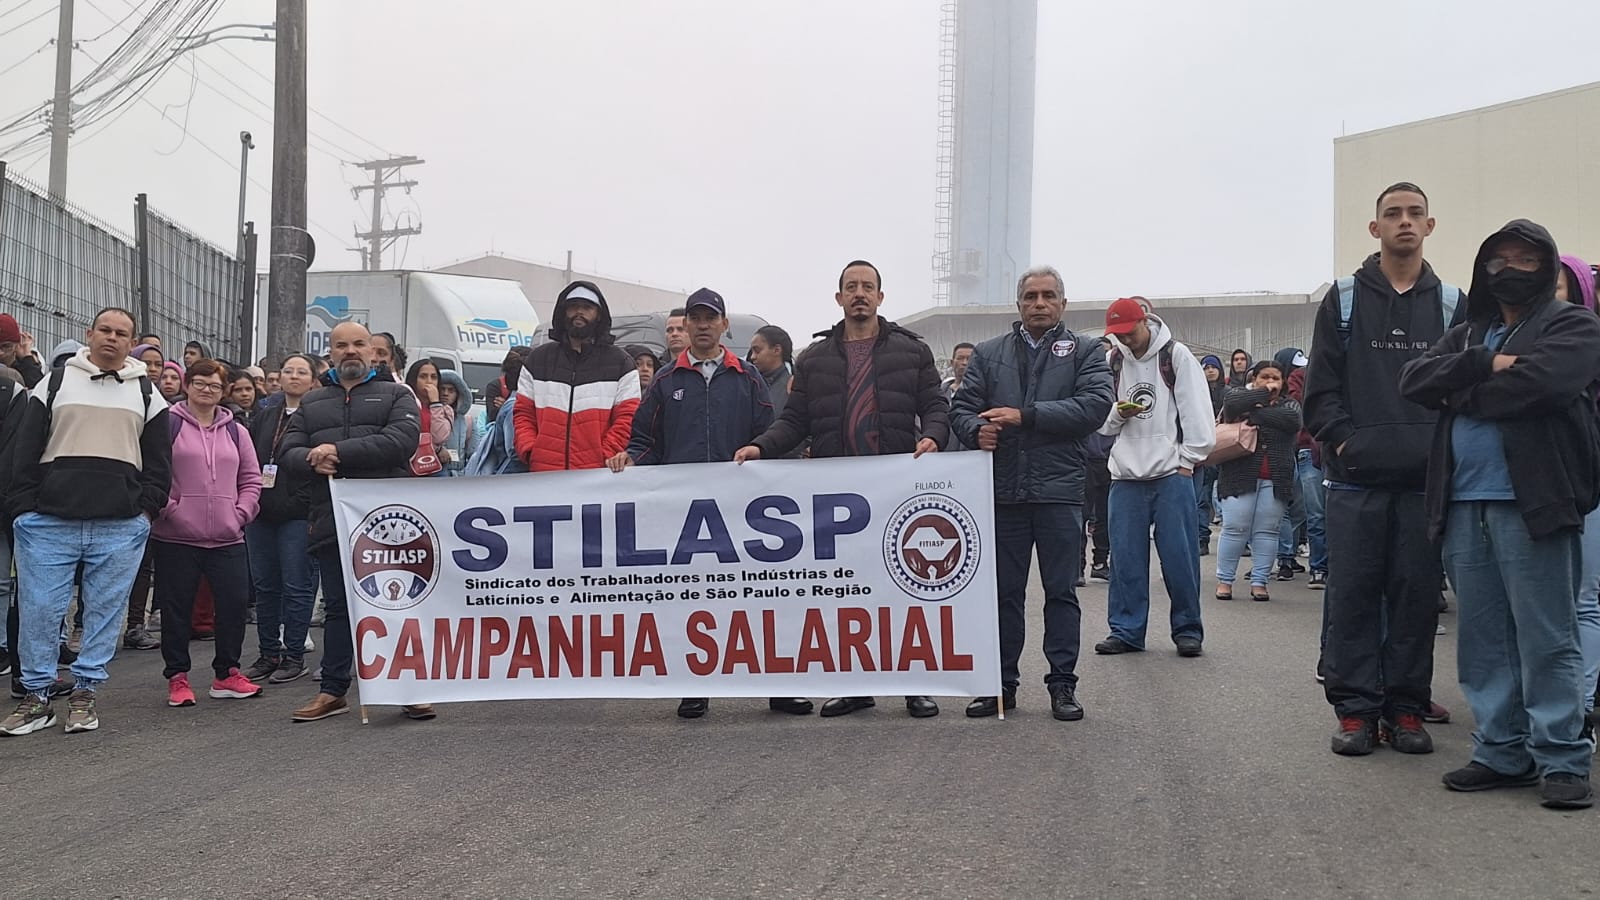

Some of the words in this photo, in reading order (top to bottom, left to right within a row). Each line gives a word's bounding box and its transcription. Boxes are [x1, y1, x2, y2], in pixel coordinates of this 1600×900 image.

[915, 482, 946, 491] FILIADO
[451, 492, 872, 573] STILASP
[919, 540, 945, 548] FITIASP
[362, 549, 428, 564] STILASP
[464, 577, 542, 590] Sindicato
[546, 576, 576, 588] dos
[580, 572, 700, 588] Trabalhadores
[706, 573, 736, 583] nas
[741, 568, 828, 582] Indústrias
[833, 567, 855, 579] de
[465, 593, 545, 606] Laticínios
[550, 595, 560, 605] e
[570, 589, 675, 605] Alimentação
[680, 588, 700, 600] de
[706, 588, 738, 600] São
[743, 586, 790, 599] Paulo
[796, 587, 806, 597] e
[812, 584, 872, 599] Região
[355, 611, 668, 681] CAMPANHA
[686, 605, 974, 676] SALARIAL
